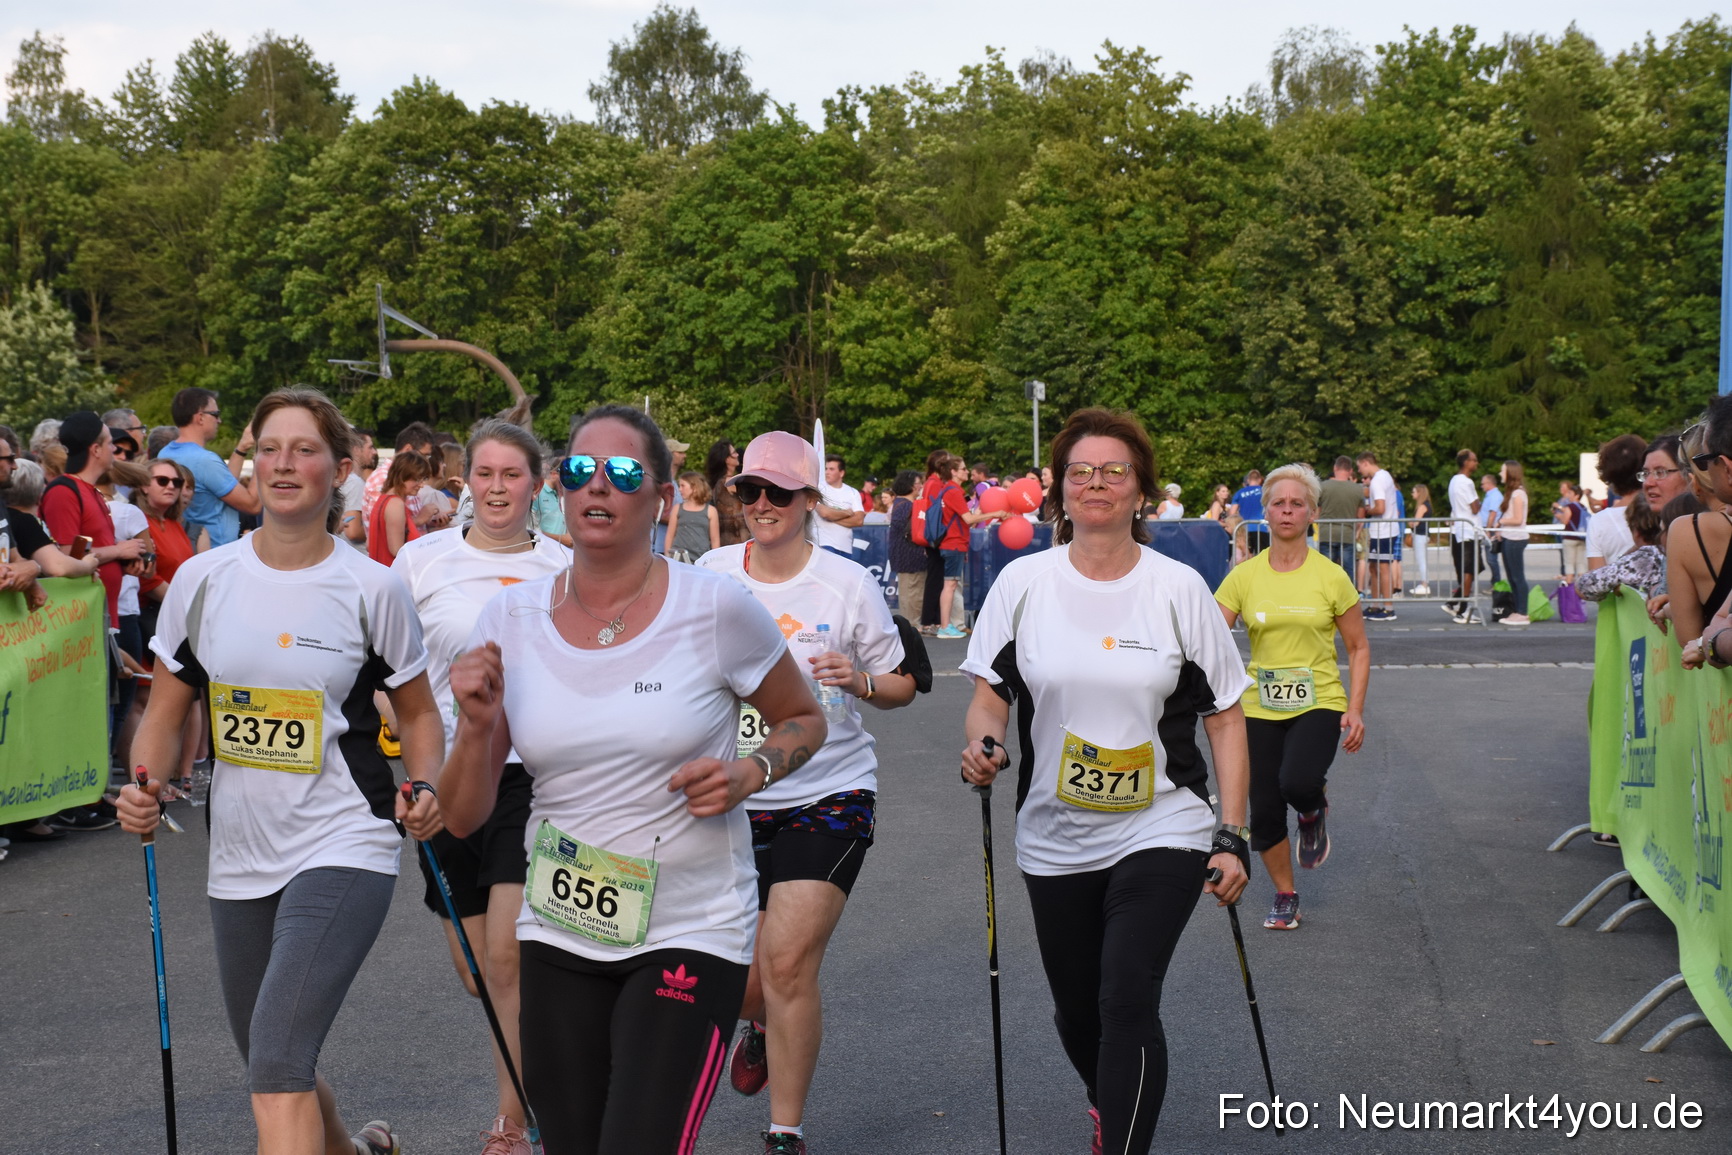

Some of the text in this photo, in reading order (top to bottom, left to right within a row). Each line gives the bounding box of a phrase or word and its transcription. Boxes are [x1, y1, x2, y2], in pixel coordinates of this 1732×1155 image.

[0, 611, 47, 649] esunde
[25, 623, 97, 684] laufen länger!
[634, 681, 662, 694] Bea
[1263, 683, 1307, 699] 1276
[224, 700, 267, 713] firmenlauf
[223, 714, 305, 749] 2379
[231, 743, 298, 759] Lukas Stephanie
[1075, 750, 1112, 768] firmenlauf
[1068, 762, 1140, 794] 2371
[1075, 788, 1105, 801] Dengler
[550, 846, 593, 873] firmenlauf
[552, 868, 619, 918] 656
[620, 882, 645, 893] 2019
[542, 903, 561, 916] Dinkel
[564, 914, 578, 924] DAS
[547, 896, 619, 931] Hiereth Cornelia
[655, 987, 695, 1004] adidas
